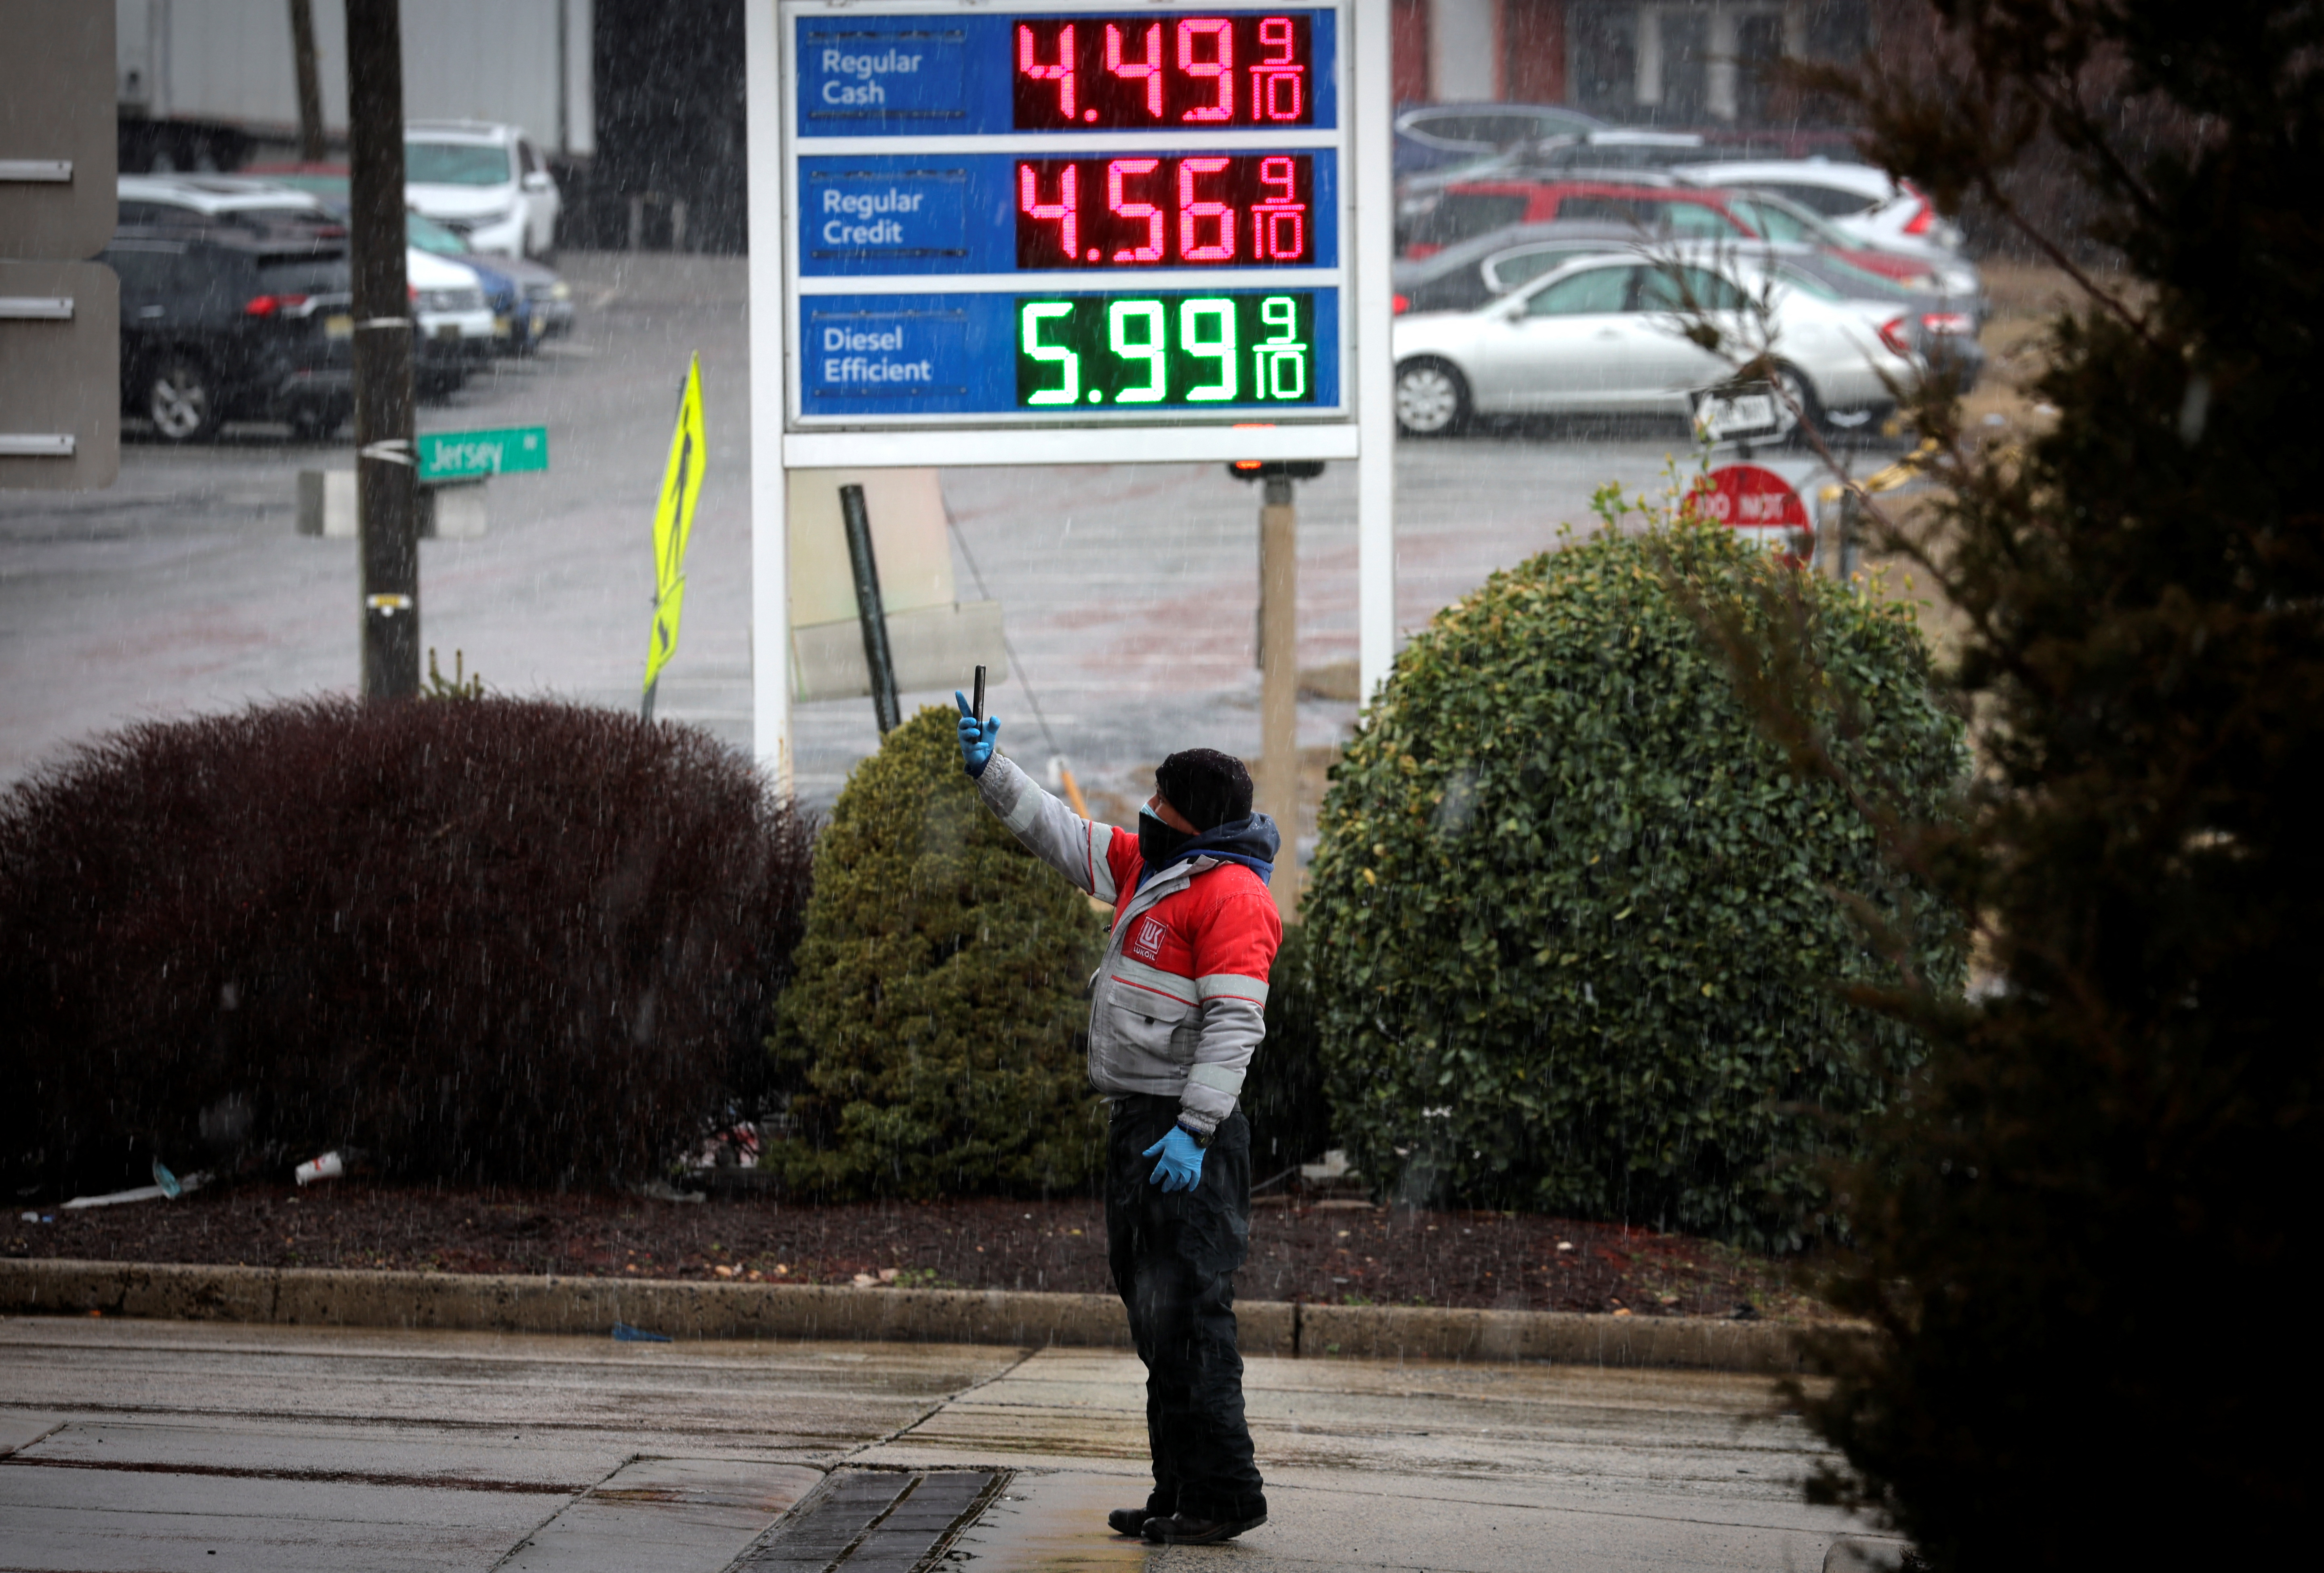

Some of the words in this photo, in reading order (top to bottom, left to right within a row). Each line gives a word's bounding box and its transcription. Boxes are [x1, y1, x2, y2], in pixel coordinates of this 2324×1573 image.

[822, 48, 922, 80] Regular
[1018, 18, 1235, 122] 4.49
[822, 80, 885, 105] Cash
[823, 187, 923, 220] Regular
[1020, 157, 1236, 262] 4.56
[823, 219, 903, 244] Credit
[824, 325, 902, 352] Diesel
[1021, 298, 1239, 404] 5.99
[824, 357, 932, 382] Efficient
[429, 438, 503, 474] Jersey
[1738, 492, 1783, 520] NOT
[1133, 946, 1155, 961] LUKOIL
